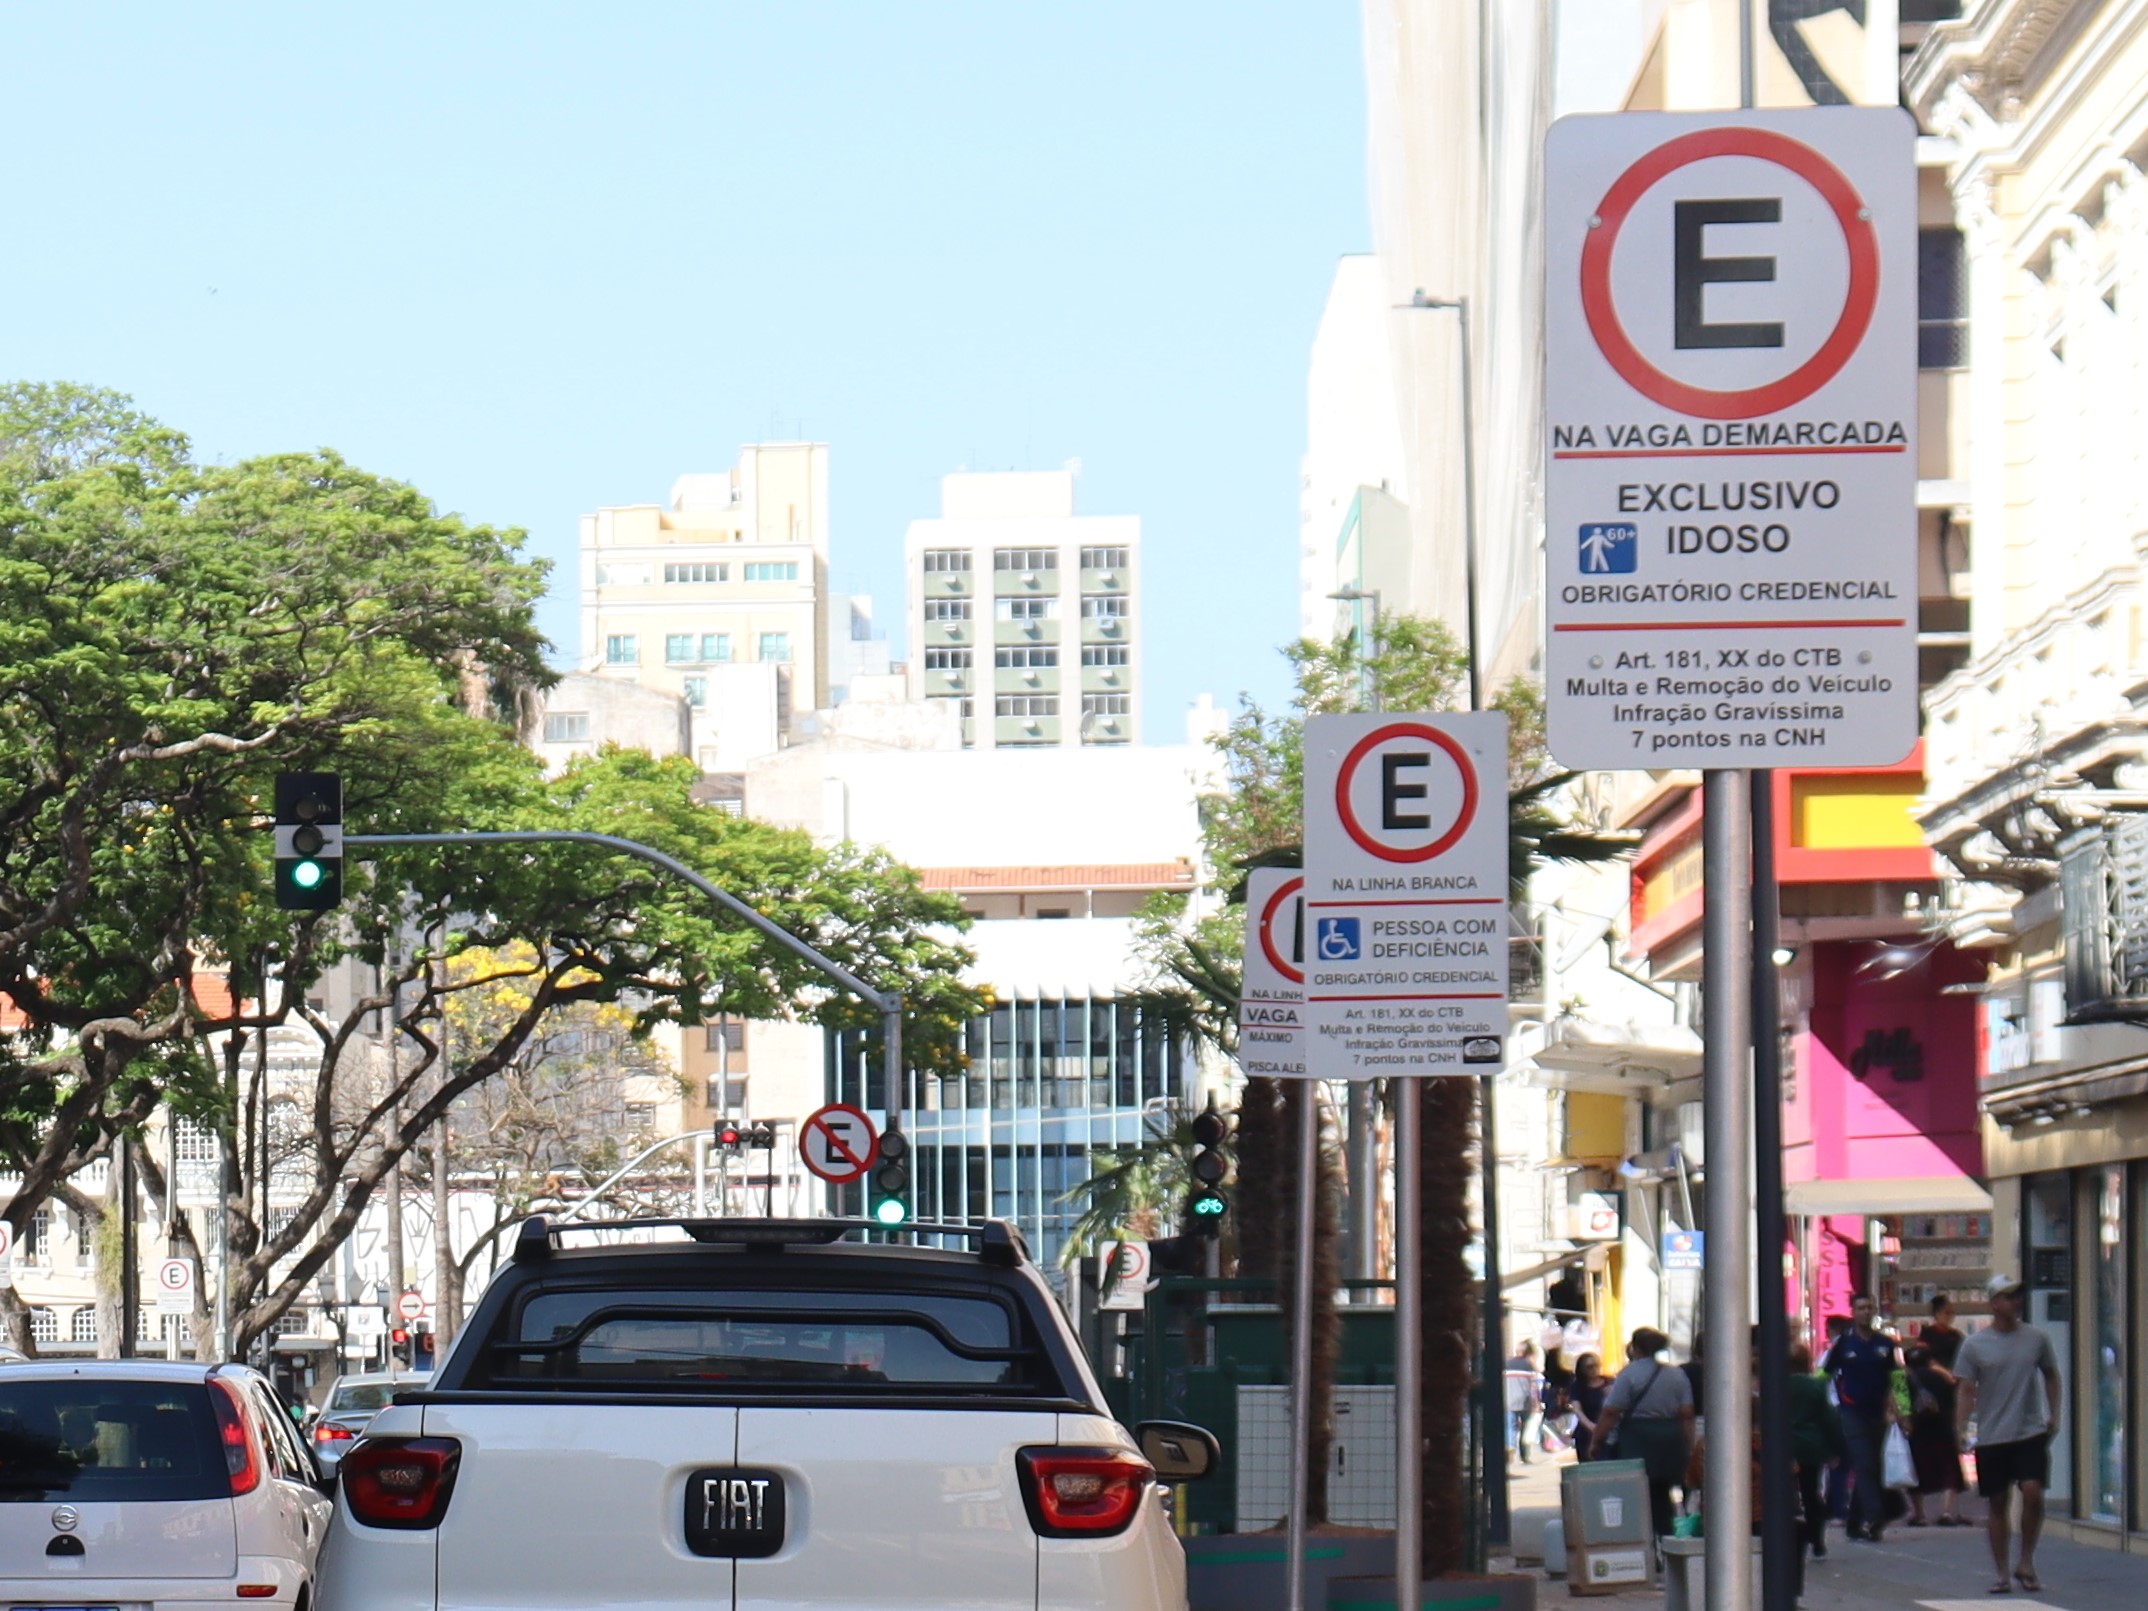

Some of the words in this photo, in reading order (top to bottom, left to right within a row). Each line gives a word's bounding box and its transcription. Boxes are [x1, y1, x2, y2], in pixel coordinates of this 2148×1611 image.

[1675, 197, 1783, 350] E
[1554, 426, 1596, 447] NA
[1606, 425, 1692, 447] VAGA
[1703, 422, 1907, 447] DEMARCADA
[1619, 481, 1839, 512] EXCLUSIVO
[1607, 528, 1636, 540] 60+
[1668, 524, 1789, 554] IDOSO
[1562, 580, 1731, 603] OBRIGATÓRIO
[1740, 582, 1896, 601] CREDENCIAL
[1616, 652, 1655, 669] Art.
[1665, 651, 1709, 670] 181,
[1718, 650, 1748, 667] XX
[1757, 650, 1785, 667] do
[1794, 649, 1841, 666] CTB
[1567, 679, 1627, 696] Multa
[1636, 682, 1647, 695] e
[1657, 677, 1763, 698] Remoção
[1772, 676, 1800, 693] do
[1808, 675, 1891, 693] Veículo
[1614, 704, 1706, 725] Infração
[1715, 702, 1843, 720] Gravíssima
[1632, 731, 1644, 748] 7
[1653, 731, 1731, 752] pontos
[1740, 733, 1766, 746] na
[1775, 729, 1824, 746] CNH
[1382, 752, 1431, 829] E
[1333, 879, 1354, 891] NA
[1360, 878, 1406, 891] LINHA
[1411, 876, 1477, 890] BRANCA
[1373, 920, 1447, 935] PESSOA
[1453, 920, 1495, 934] COM
[1373, 939, 1488, 958] DEFICIÊNCIA
[1314, 970, 1408, 985] OBRIGATÓRIO
[1413, 971, 1498, 983] CREDENCIAL
[1250, 990, 1270, 1000] NA
[1247, 1008, 1298, 1024] VAGA
[1399, 1008, 1415, 1018] XX
[1418, 1009, 1434, 1018] do
[1438, 1007, 1463, 1017] CTB
[1320, 1025, 1352, 1036] Multa
[1367, 1024, 1423, 1037] Remoção
[1427, 1024, 1443, 1033] do
[1345, 1039, 1394, 1051] Infração
[1248, 1061, 1280, 1072] PISCA
[1282, 1062, 1306, 1074] ALE
[1353, 1054, 1360, 1064] 7
[1365, 1055, 1405, 1066] pontos
[1428, 1053, 1456, 1063] CNH
[826, 1123, 853, 1163] E
[170, 1267, 180, 1284] E
[703, 1479, 769, 1530] FIAT
